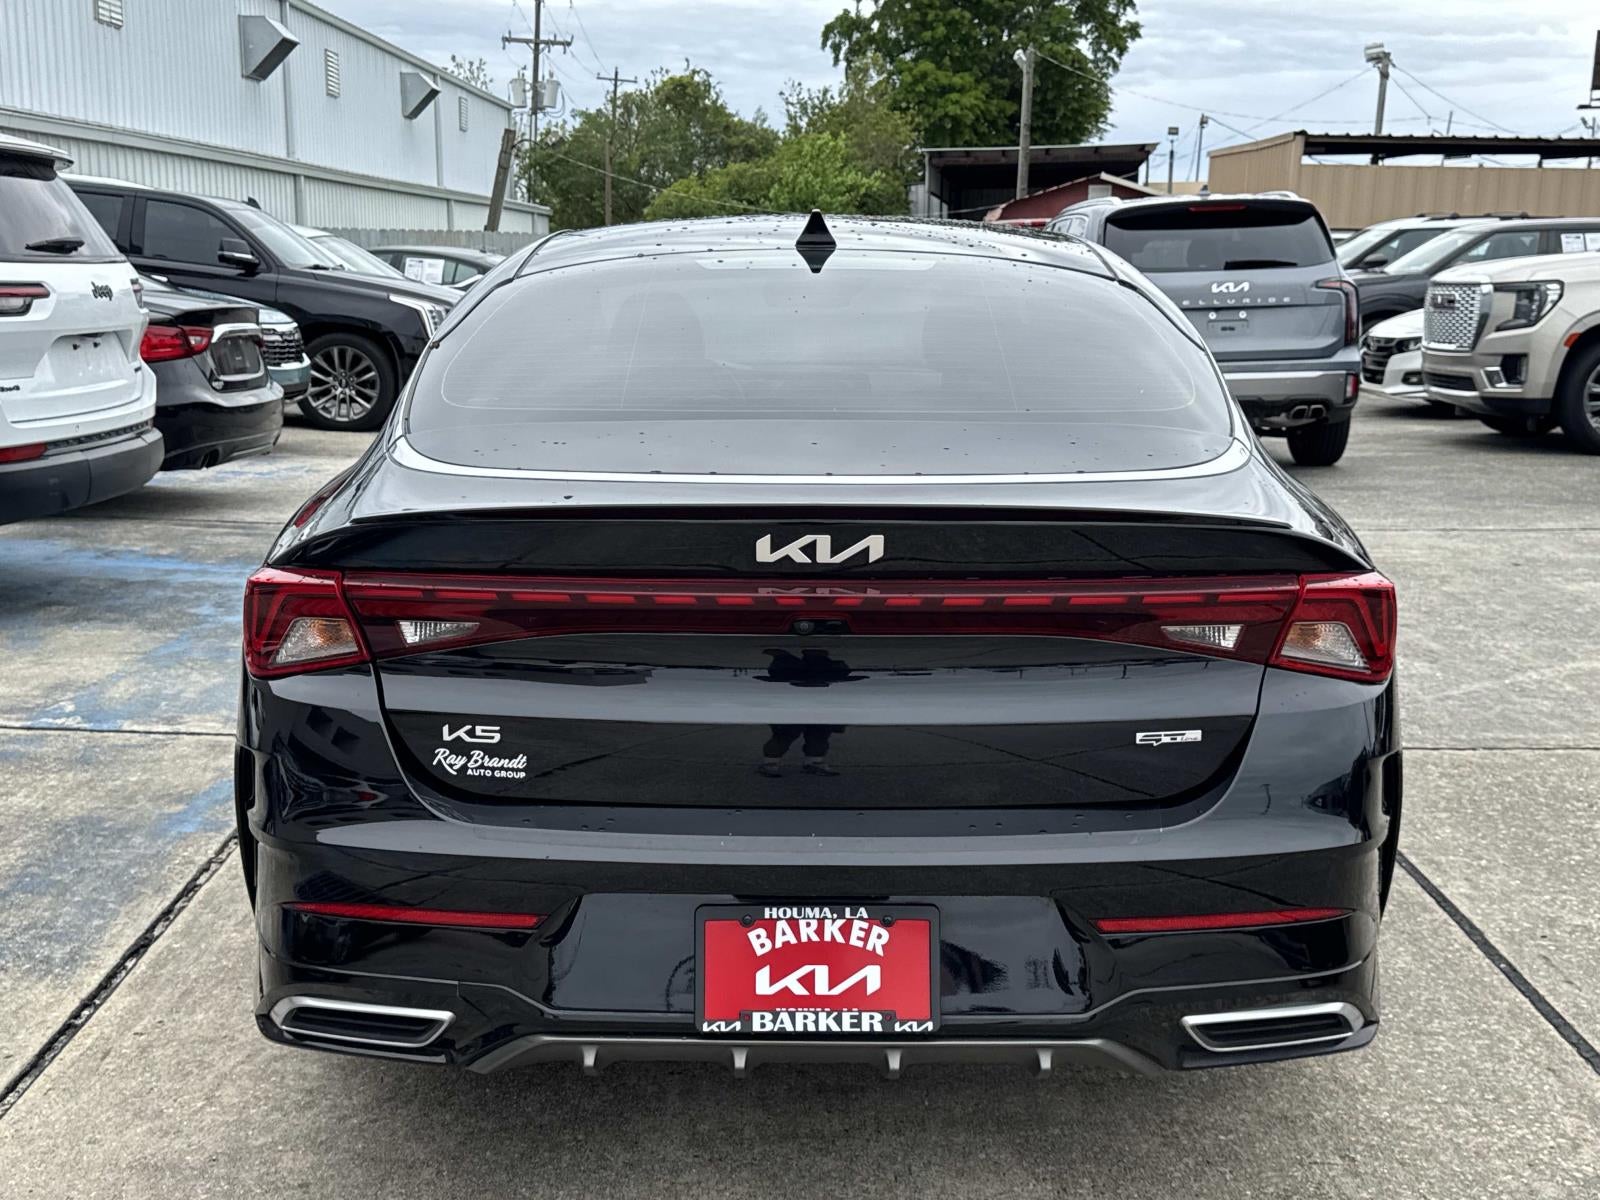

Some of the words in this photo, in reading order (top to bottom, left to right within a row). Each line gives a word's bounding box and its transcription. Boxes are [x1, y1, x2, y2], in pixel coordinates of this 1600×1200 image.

[91, 281, 113, 301] Jeep
[1211, 281, 1250, 293] KIA
[1182, 296, 1290, 306] ELLURIDE
[755, 533, 885, 563] KIA
[442, 723, 501, 743] K5
[432, 748, 468, 776] Ray
[467, 750, 528, 769] Brandt
[466, 768, 492, 777] AUTO
[493, 769, 527, 779] GROUP
[764, 907, 838, 920] HOUMA,
[844, 907, 869, 919] LA
[747, 919, 890, 957] BARKER
[755, 964, 881, 996] KIA
[702, 1020, 742, 1032] KIA
[752, 1011, 883, 1032] BARKER
[894, 1020, 934, 1032] KIA
